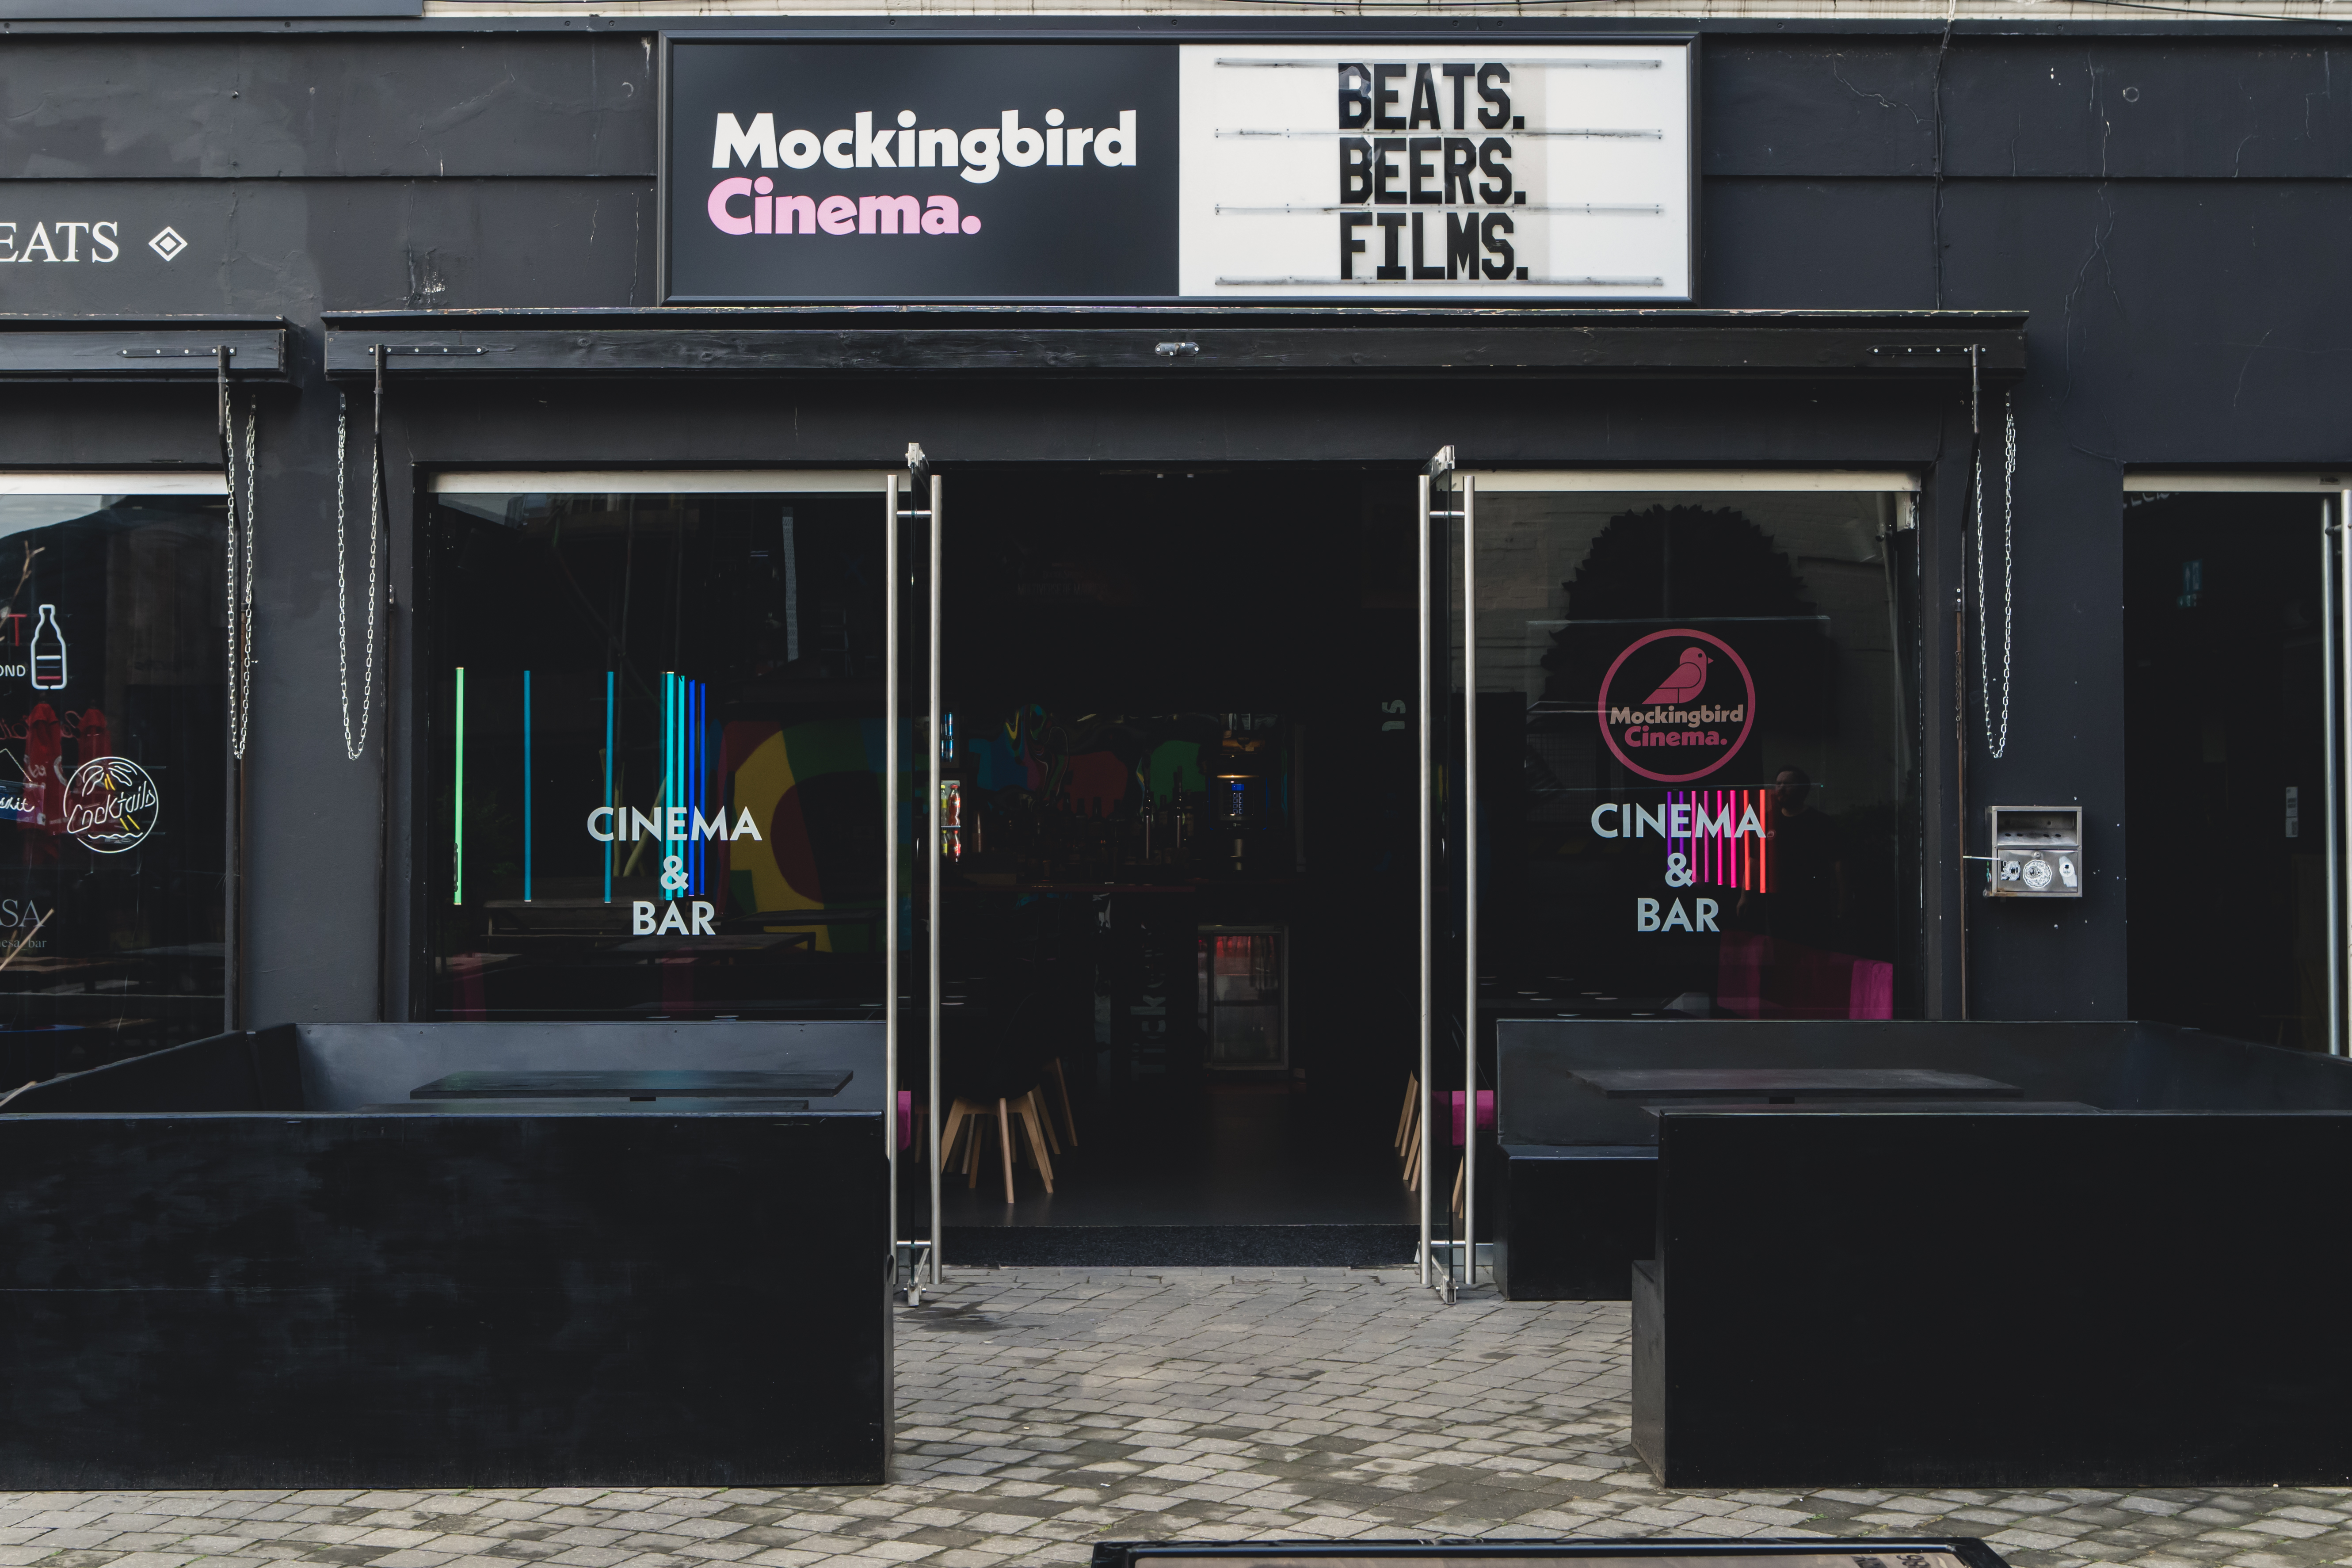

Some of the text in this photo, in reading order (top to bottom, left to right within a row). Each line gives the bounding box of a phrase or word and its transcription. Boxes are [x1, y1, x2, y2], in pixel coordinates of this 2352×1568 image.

[1338, 63, 1525, 130] BEATS.
[712, 109, 1136, 183] Mockingbird
[1339, 137, 1526, 205] BEERS.
[707, 176, 981, 235] Cinema.
[1340, 212, 1529, 280] FILMS.
[1610, 704, 1744, 728] Mockingbird
[1624, 725, 1728, 747] Cinema.
[67, 780, 156, 834] Cocktails
[587, 805, 763, 842] CINEMA
[1591, 803, 1766, 839] CINEMA
[660, 855, 689, 890] &
[1665, 852, 1693, 887] &
[633, 900, 716, 935] BAR
[1638, 897, 1720, 931] BAR
